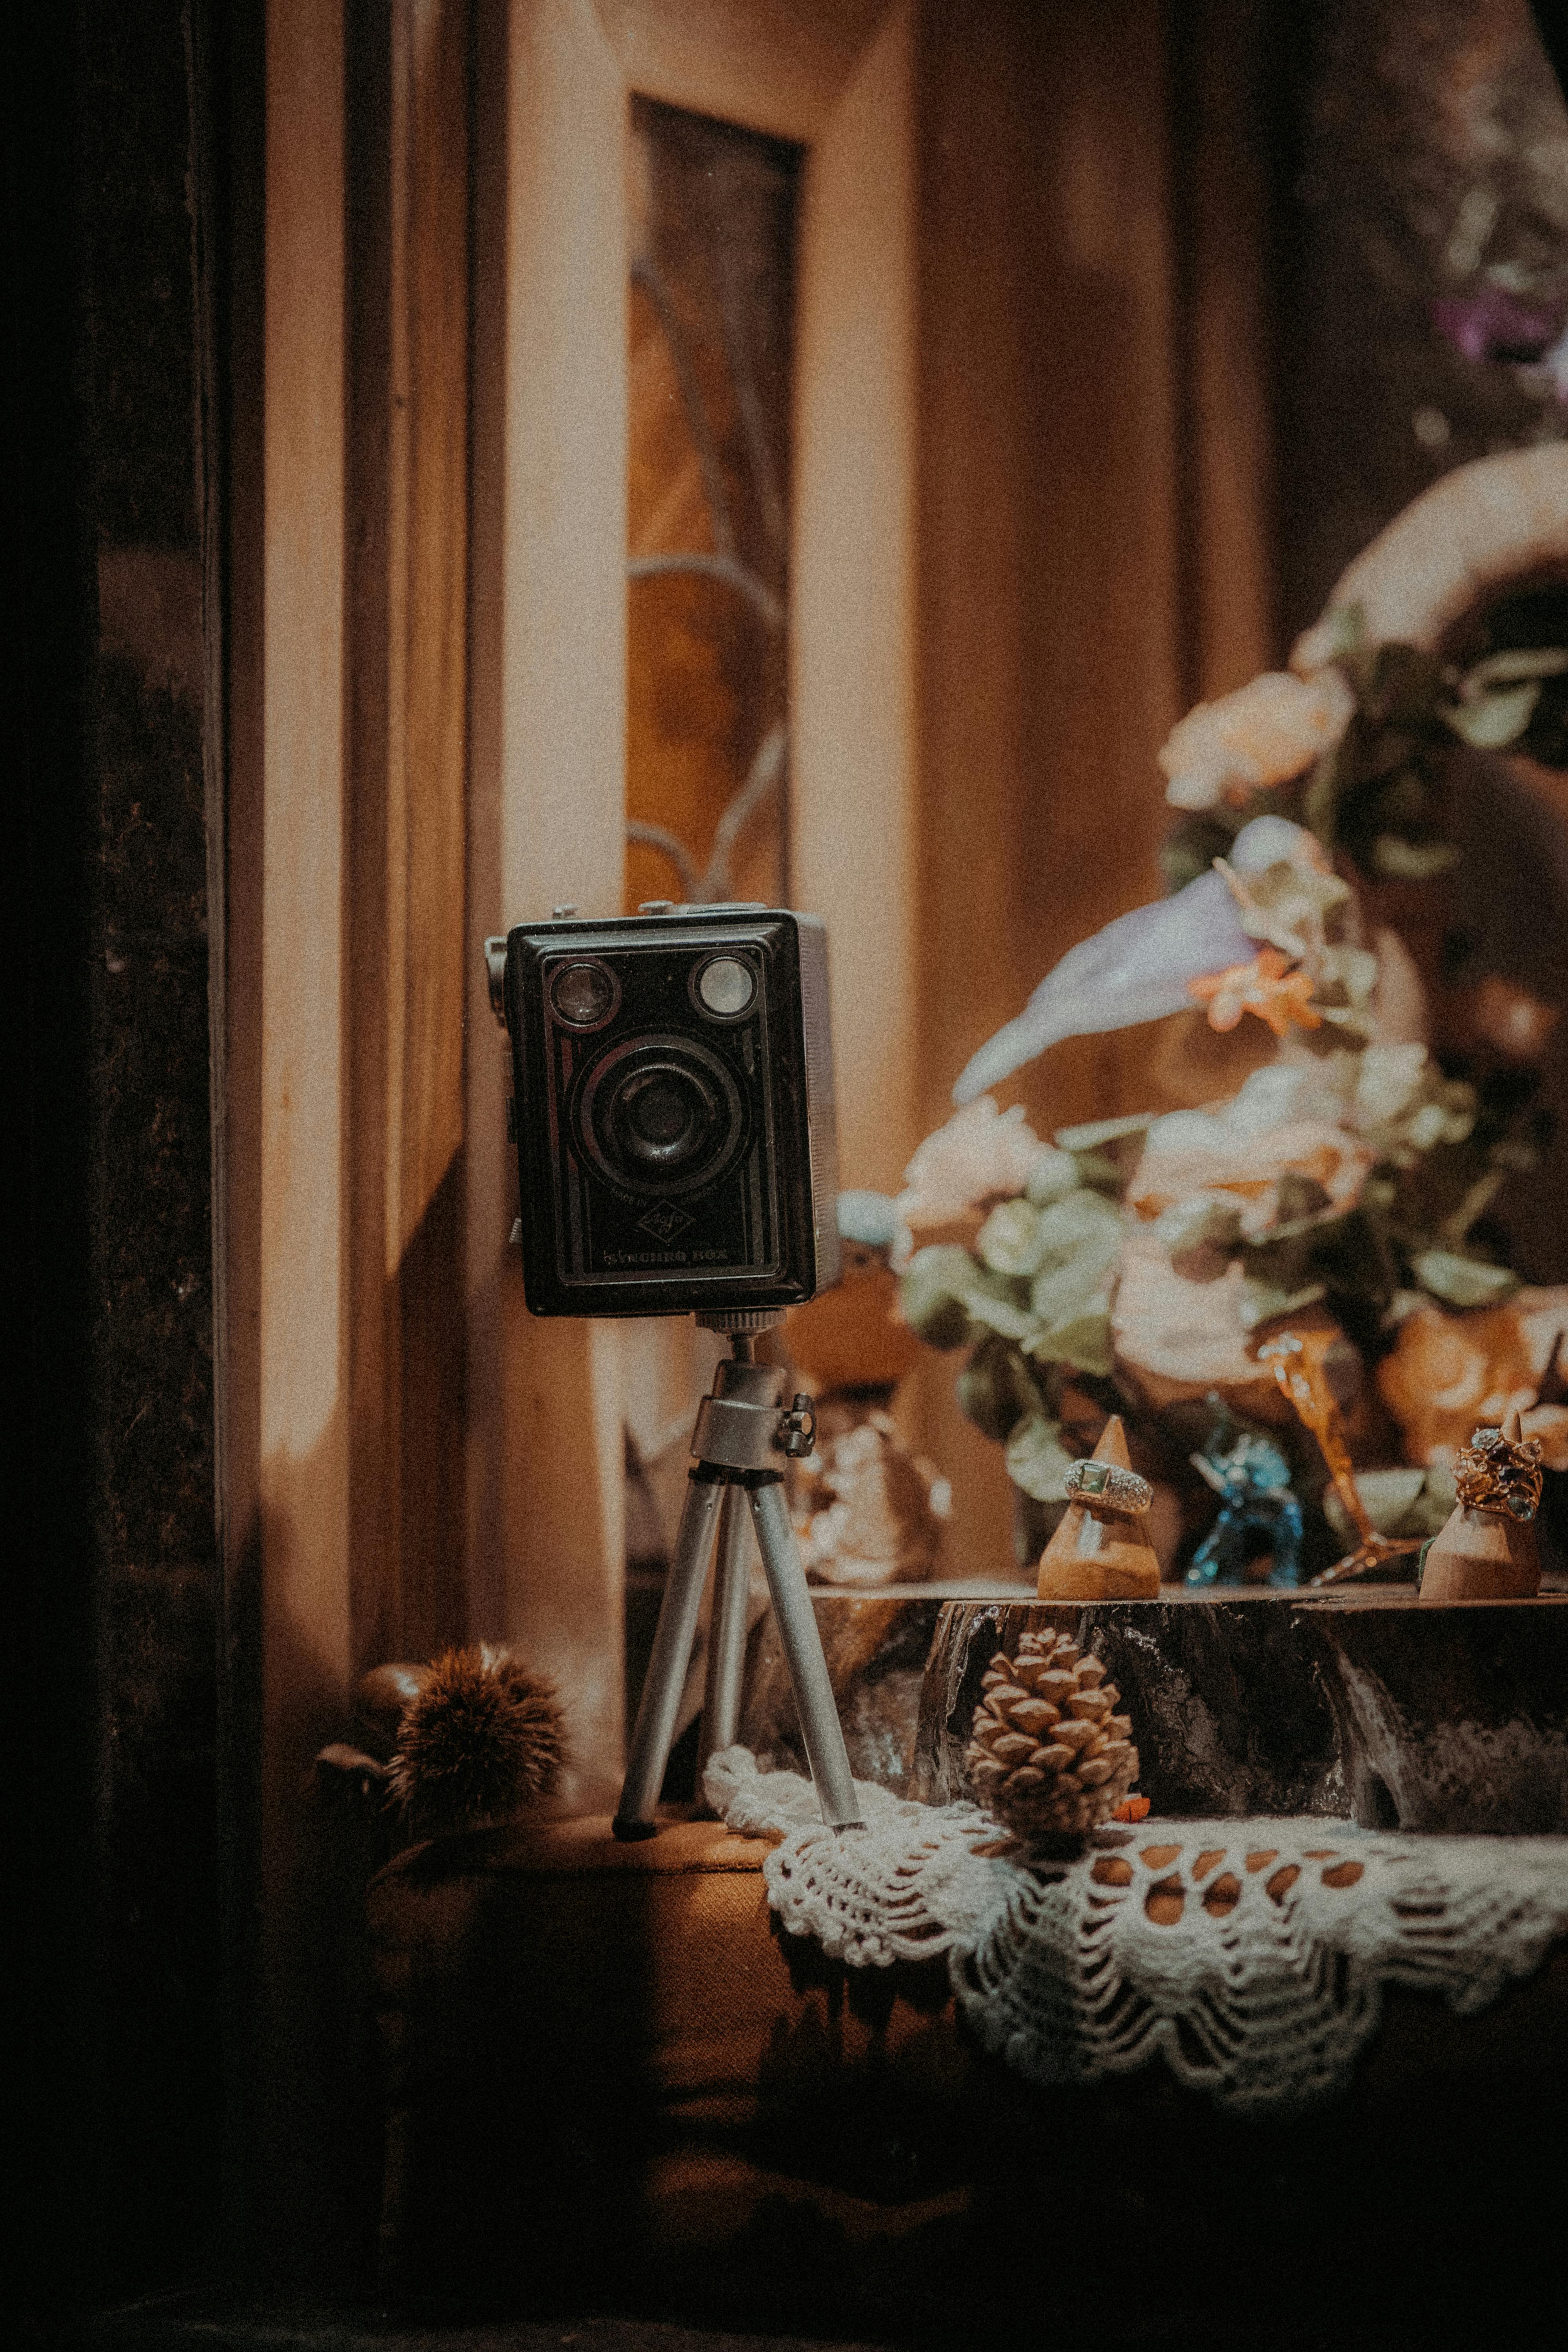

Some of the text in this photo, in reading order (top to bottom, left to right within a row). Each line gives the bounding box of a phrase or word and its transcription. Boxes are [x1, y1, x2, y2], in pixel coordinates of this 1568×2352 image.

[644, 1211, 683, 1234] Agfa
[604, 1249, 728, 1263] SYNCHRO BOX
